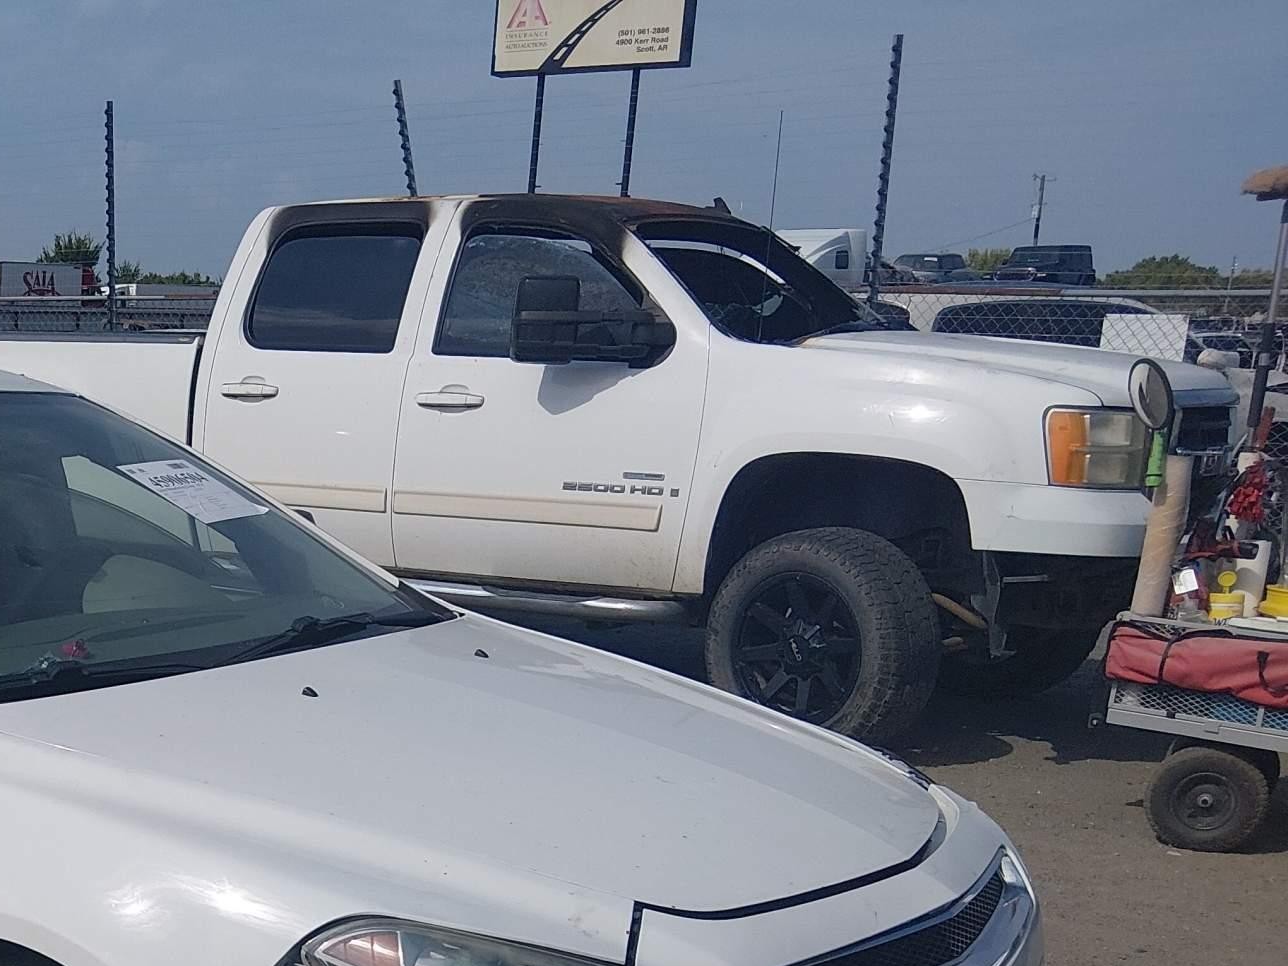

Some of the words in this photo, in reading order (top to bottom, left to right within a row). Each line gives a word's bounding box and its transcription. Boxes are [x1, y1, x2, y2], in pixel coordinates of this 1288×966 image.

[23, 269, 56, 292] SAIA
[562, 481, 626, 494] 2500
[630, 484, 664, 497] HD
